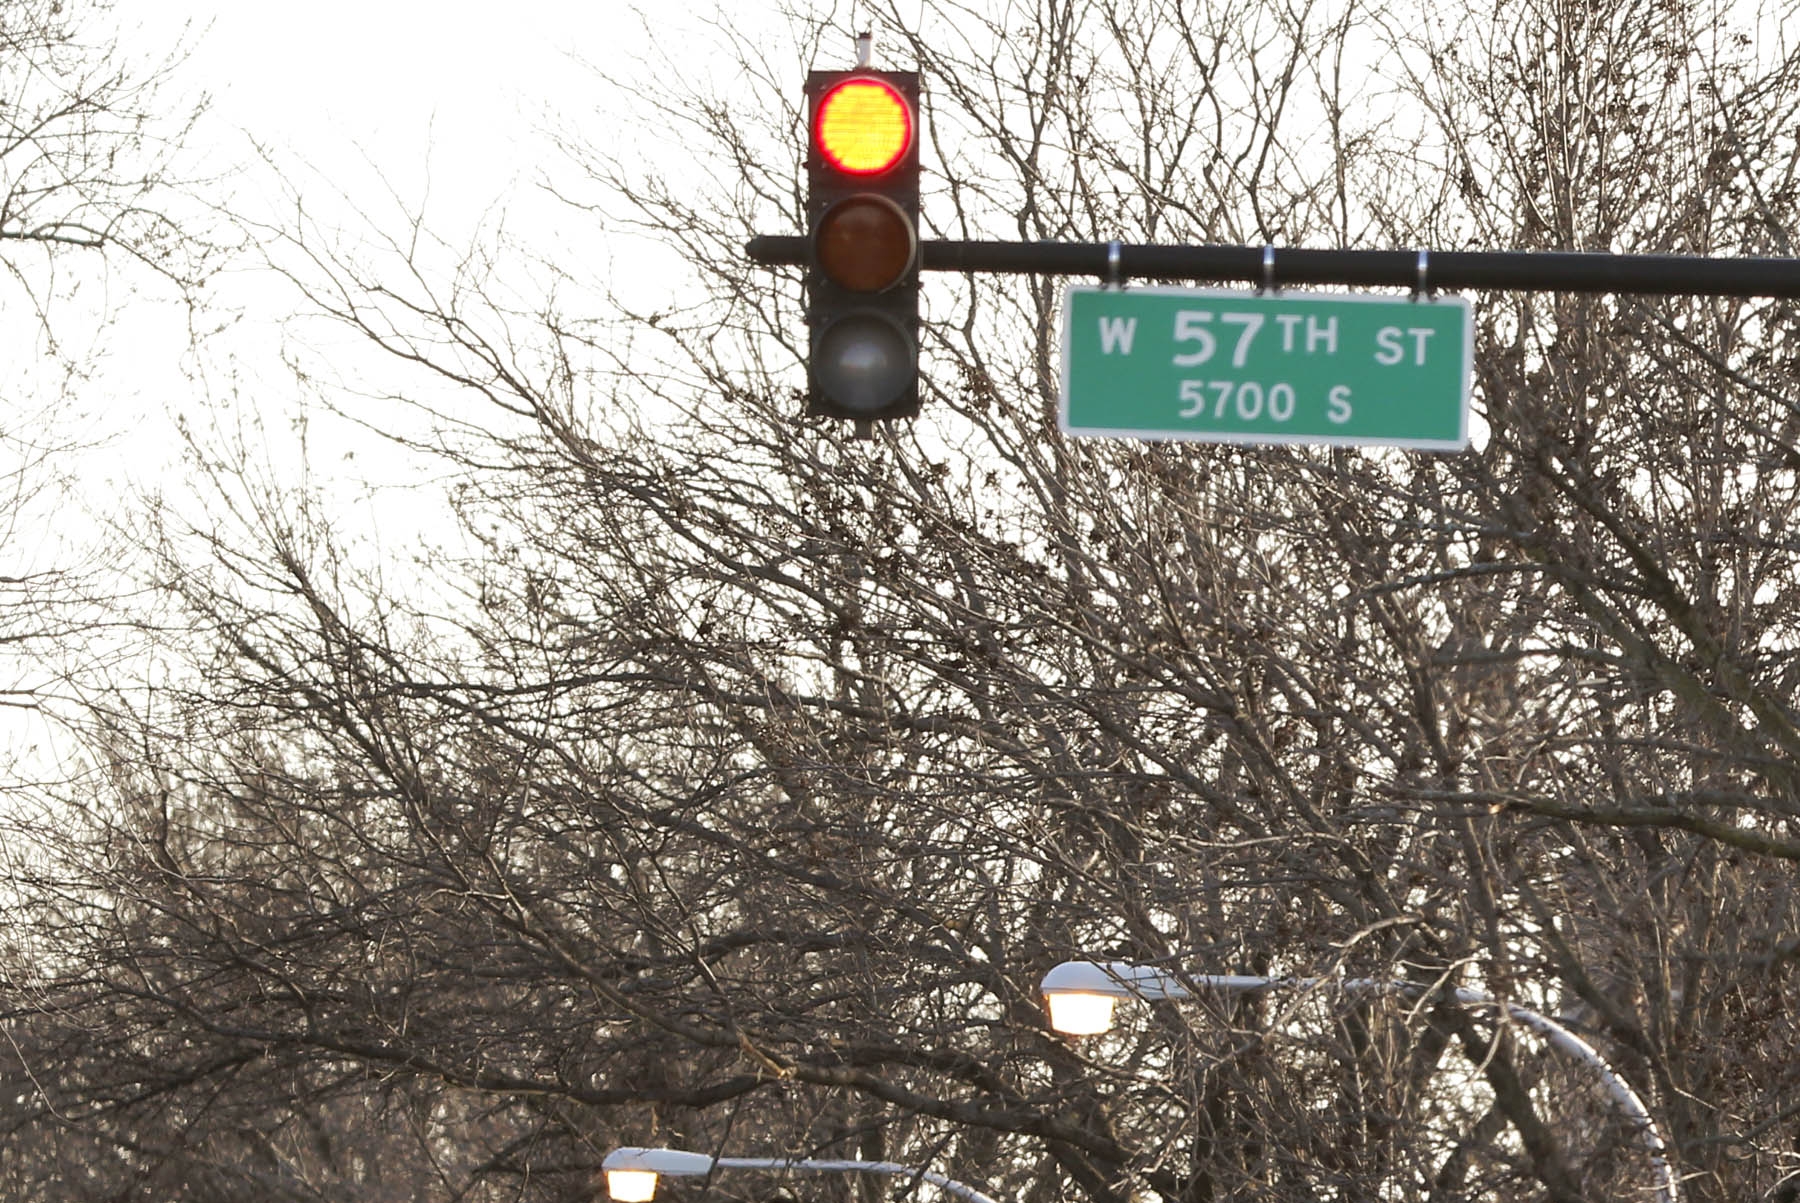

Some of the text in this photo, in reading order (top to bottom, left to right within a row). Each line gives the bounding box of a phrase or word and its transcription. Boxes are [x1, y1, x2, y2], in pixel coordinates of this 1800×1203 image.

[1099, 310, 1435, 368] W 57TH ST
[1178, 380, 1352, 424] 5700 S
